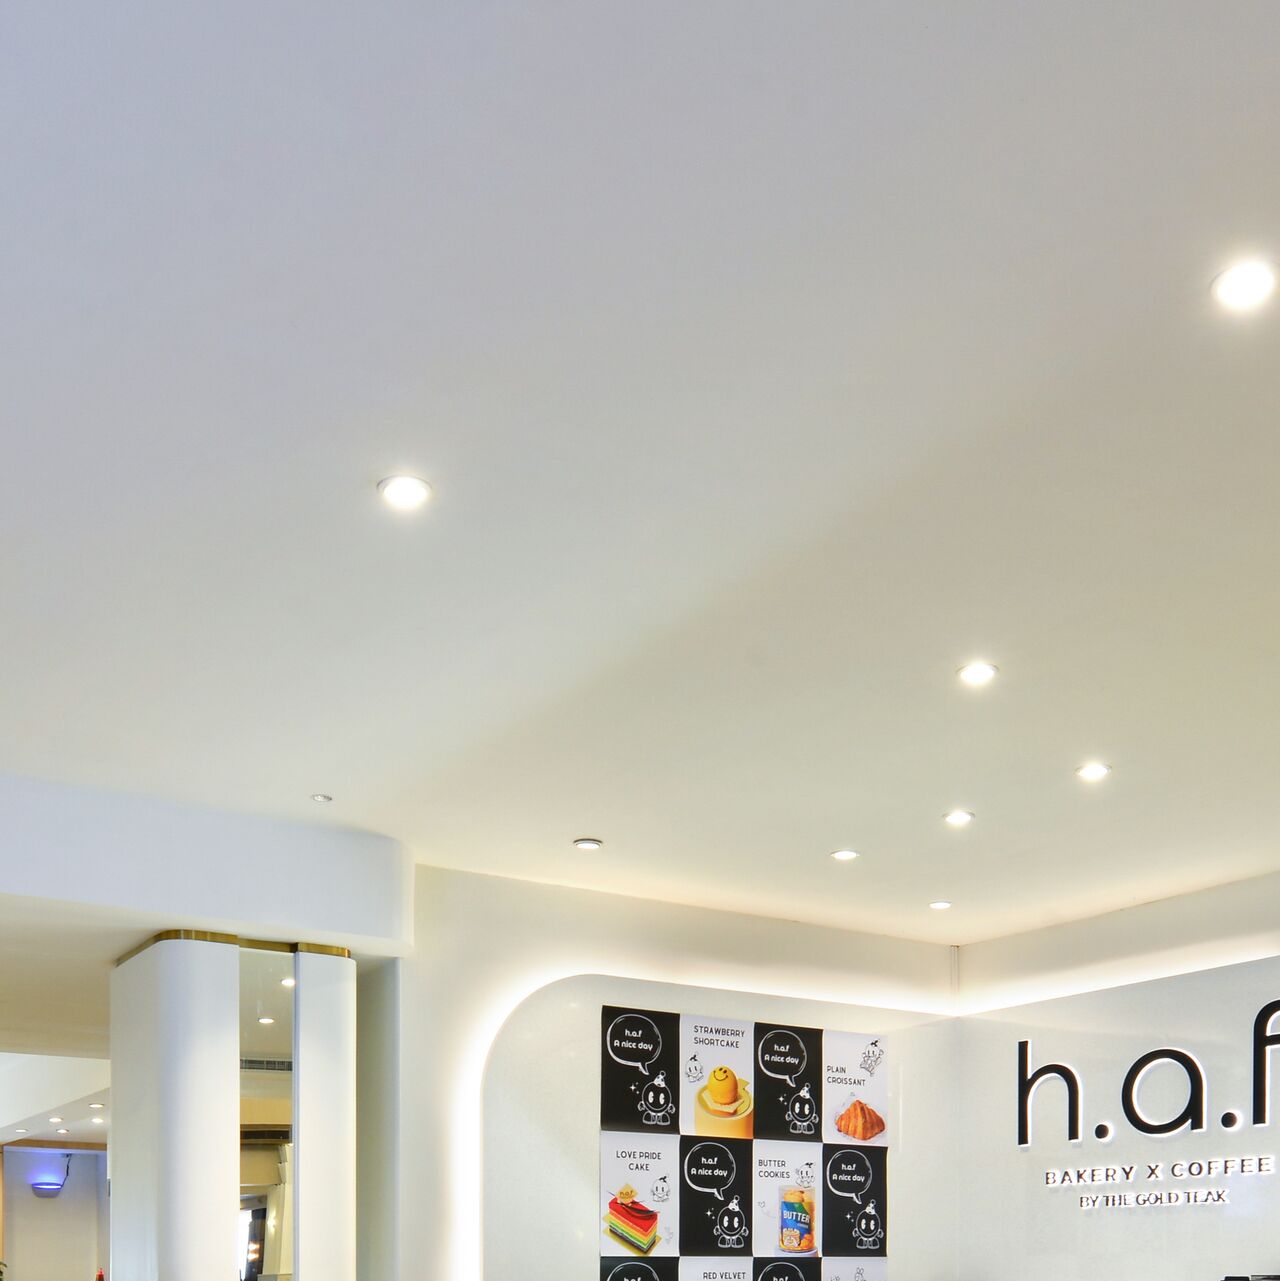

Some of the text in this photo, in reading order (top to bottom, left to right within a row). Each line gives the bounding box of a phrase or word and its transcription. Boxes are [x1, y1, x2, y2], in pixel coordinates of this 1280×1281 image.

[693, 1025, 746, 1038] STRAWBERRY
[613, 1040, 653, 1051] A nice day
[693, 1037, 740, 1049] SHORTCAKE
[771, 1054, 785, 1063] nice
[786, 1055, 799, 1065] day
[826, 1065, 846, 1074] PLAIN
[826, 1076, 866, 1087] CROISSANT
[616, 1150, 661, 1160] LOVE PRIDE
[628, 1162, 650, 1171] CAKE
[758, 1159, 786, 1168] BUTTER
[690, 1167, 728, 1177] A nice day
[758, 1170, 790, 1179] COOKIES
[1045, 1157, 1273, 1185] BAKERY X COFFEE
[852, 1174, 865, 1182] day
[1079, 1189, 1228, 1209] BY THE GOLD TEAK
[783, 1210, 810, 1223] BUTTER
[702, 1271, 746, 1280] RED VELVET
